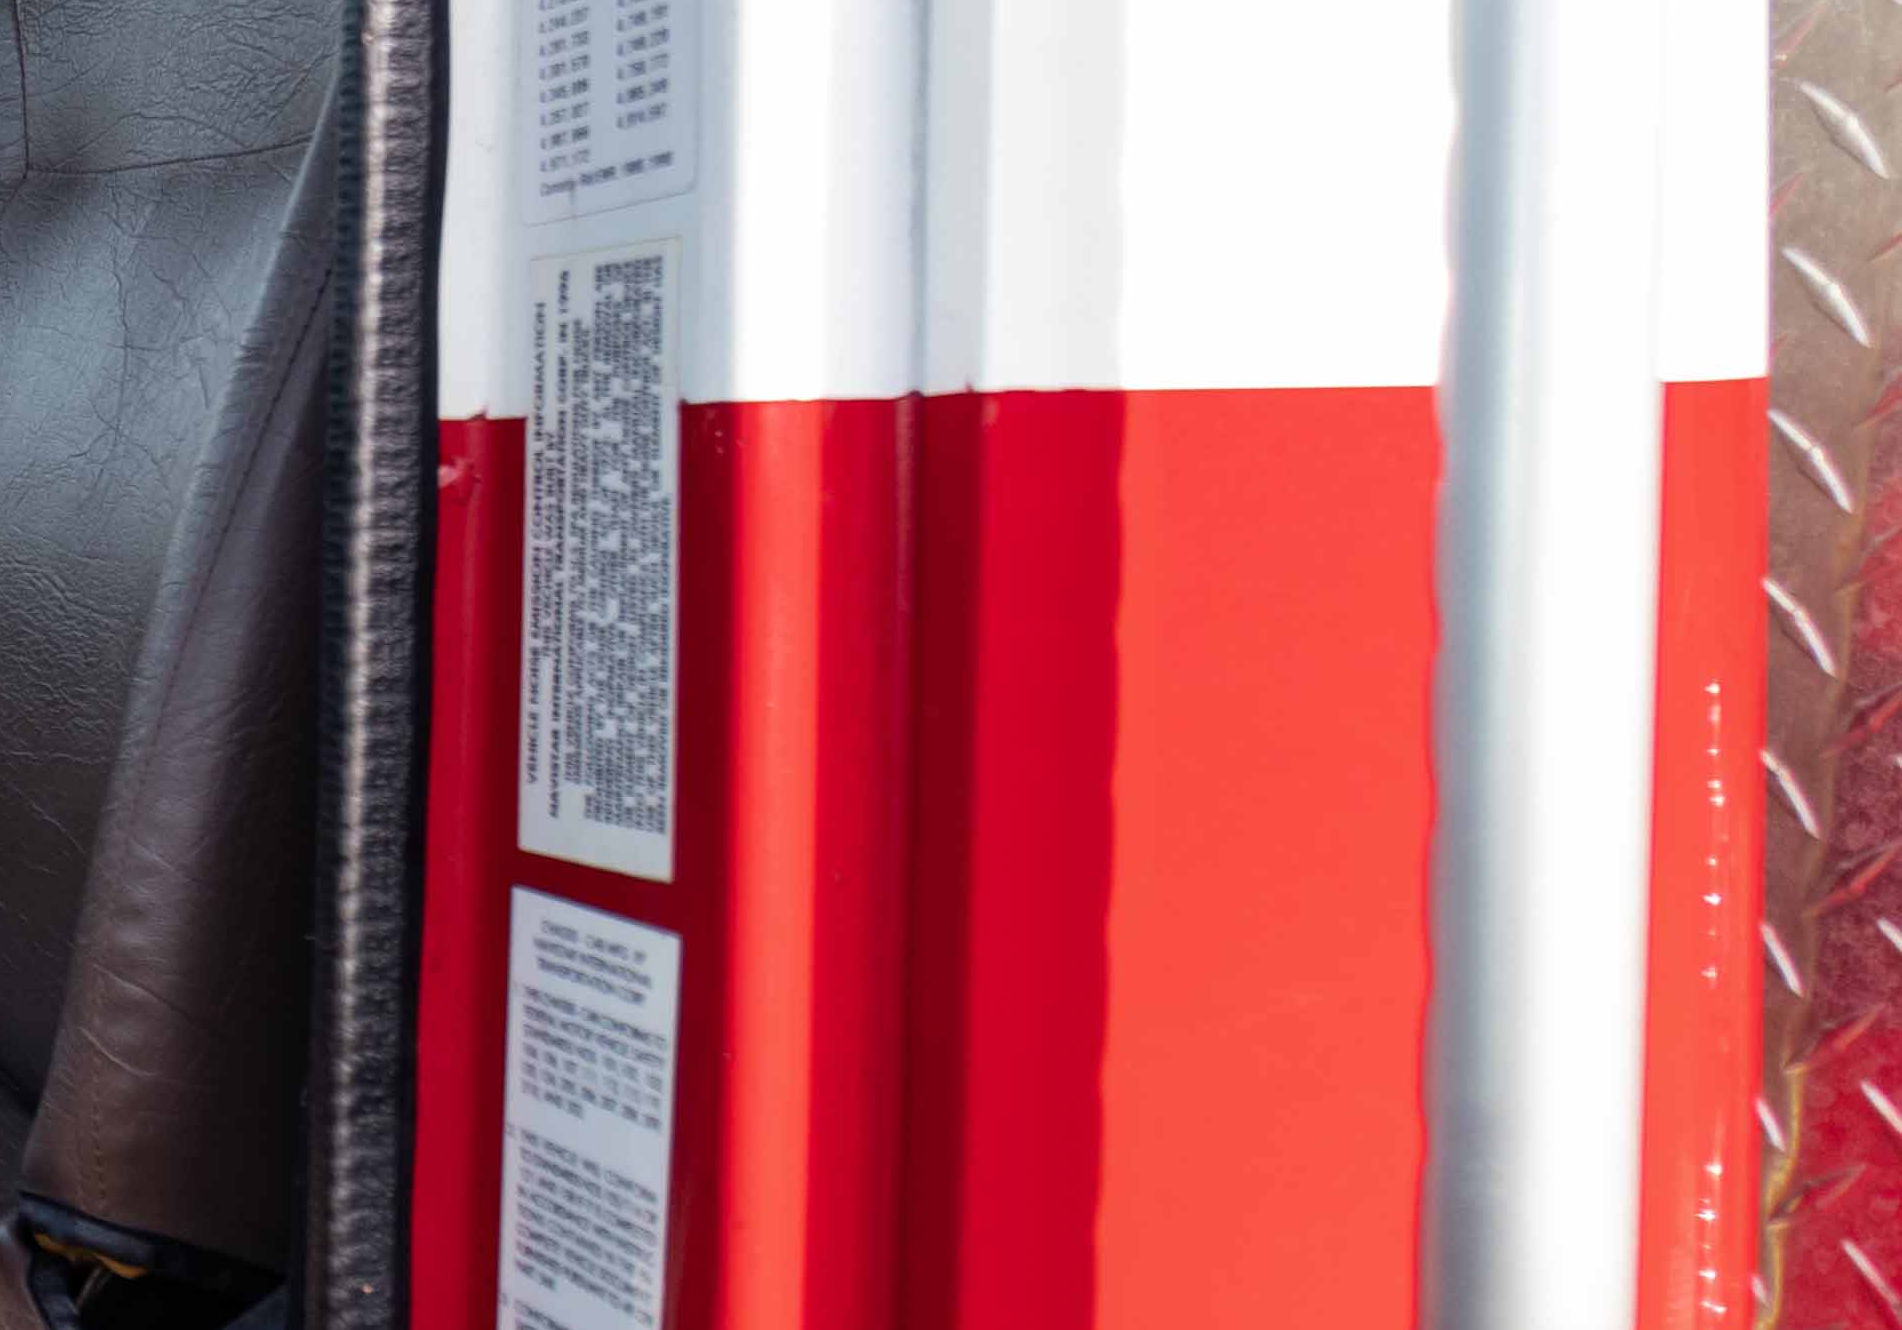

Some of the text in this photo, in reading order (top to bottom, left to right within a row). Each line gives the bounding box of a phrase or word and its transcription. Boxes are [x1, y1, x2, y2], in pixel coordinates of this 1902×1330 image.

[527, 300, 547, 784] VEHICLE NOISE EMISSION CONTROL INFORMATION
[554, 410, 567, 571] TRANSPORTATION
[551, 581, 563, 722] INTERNATIONAL
[548, 727, 560, 819] NAVISTAR
